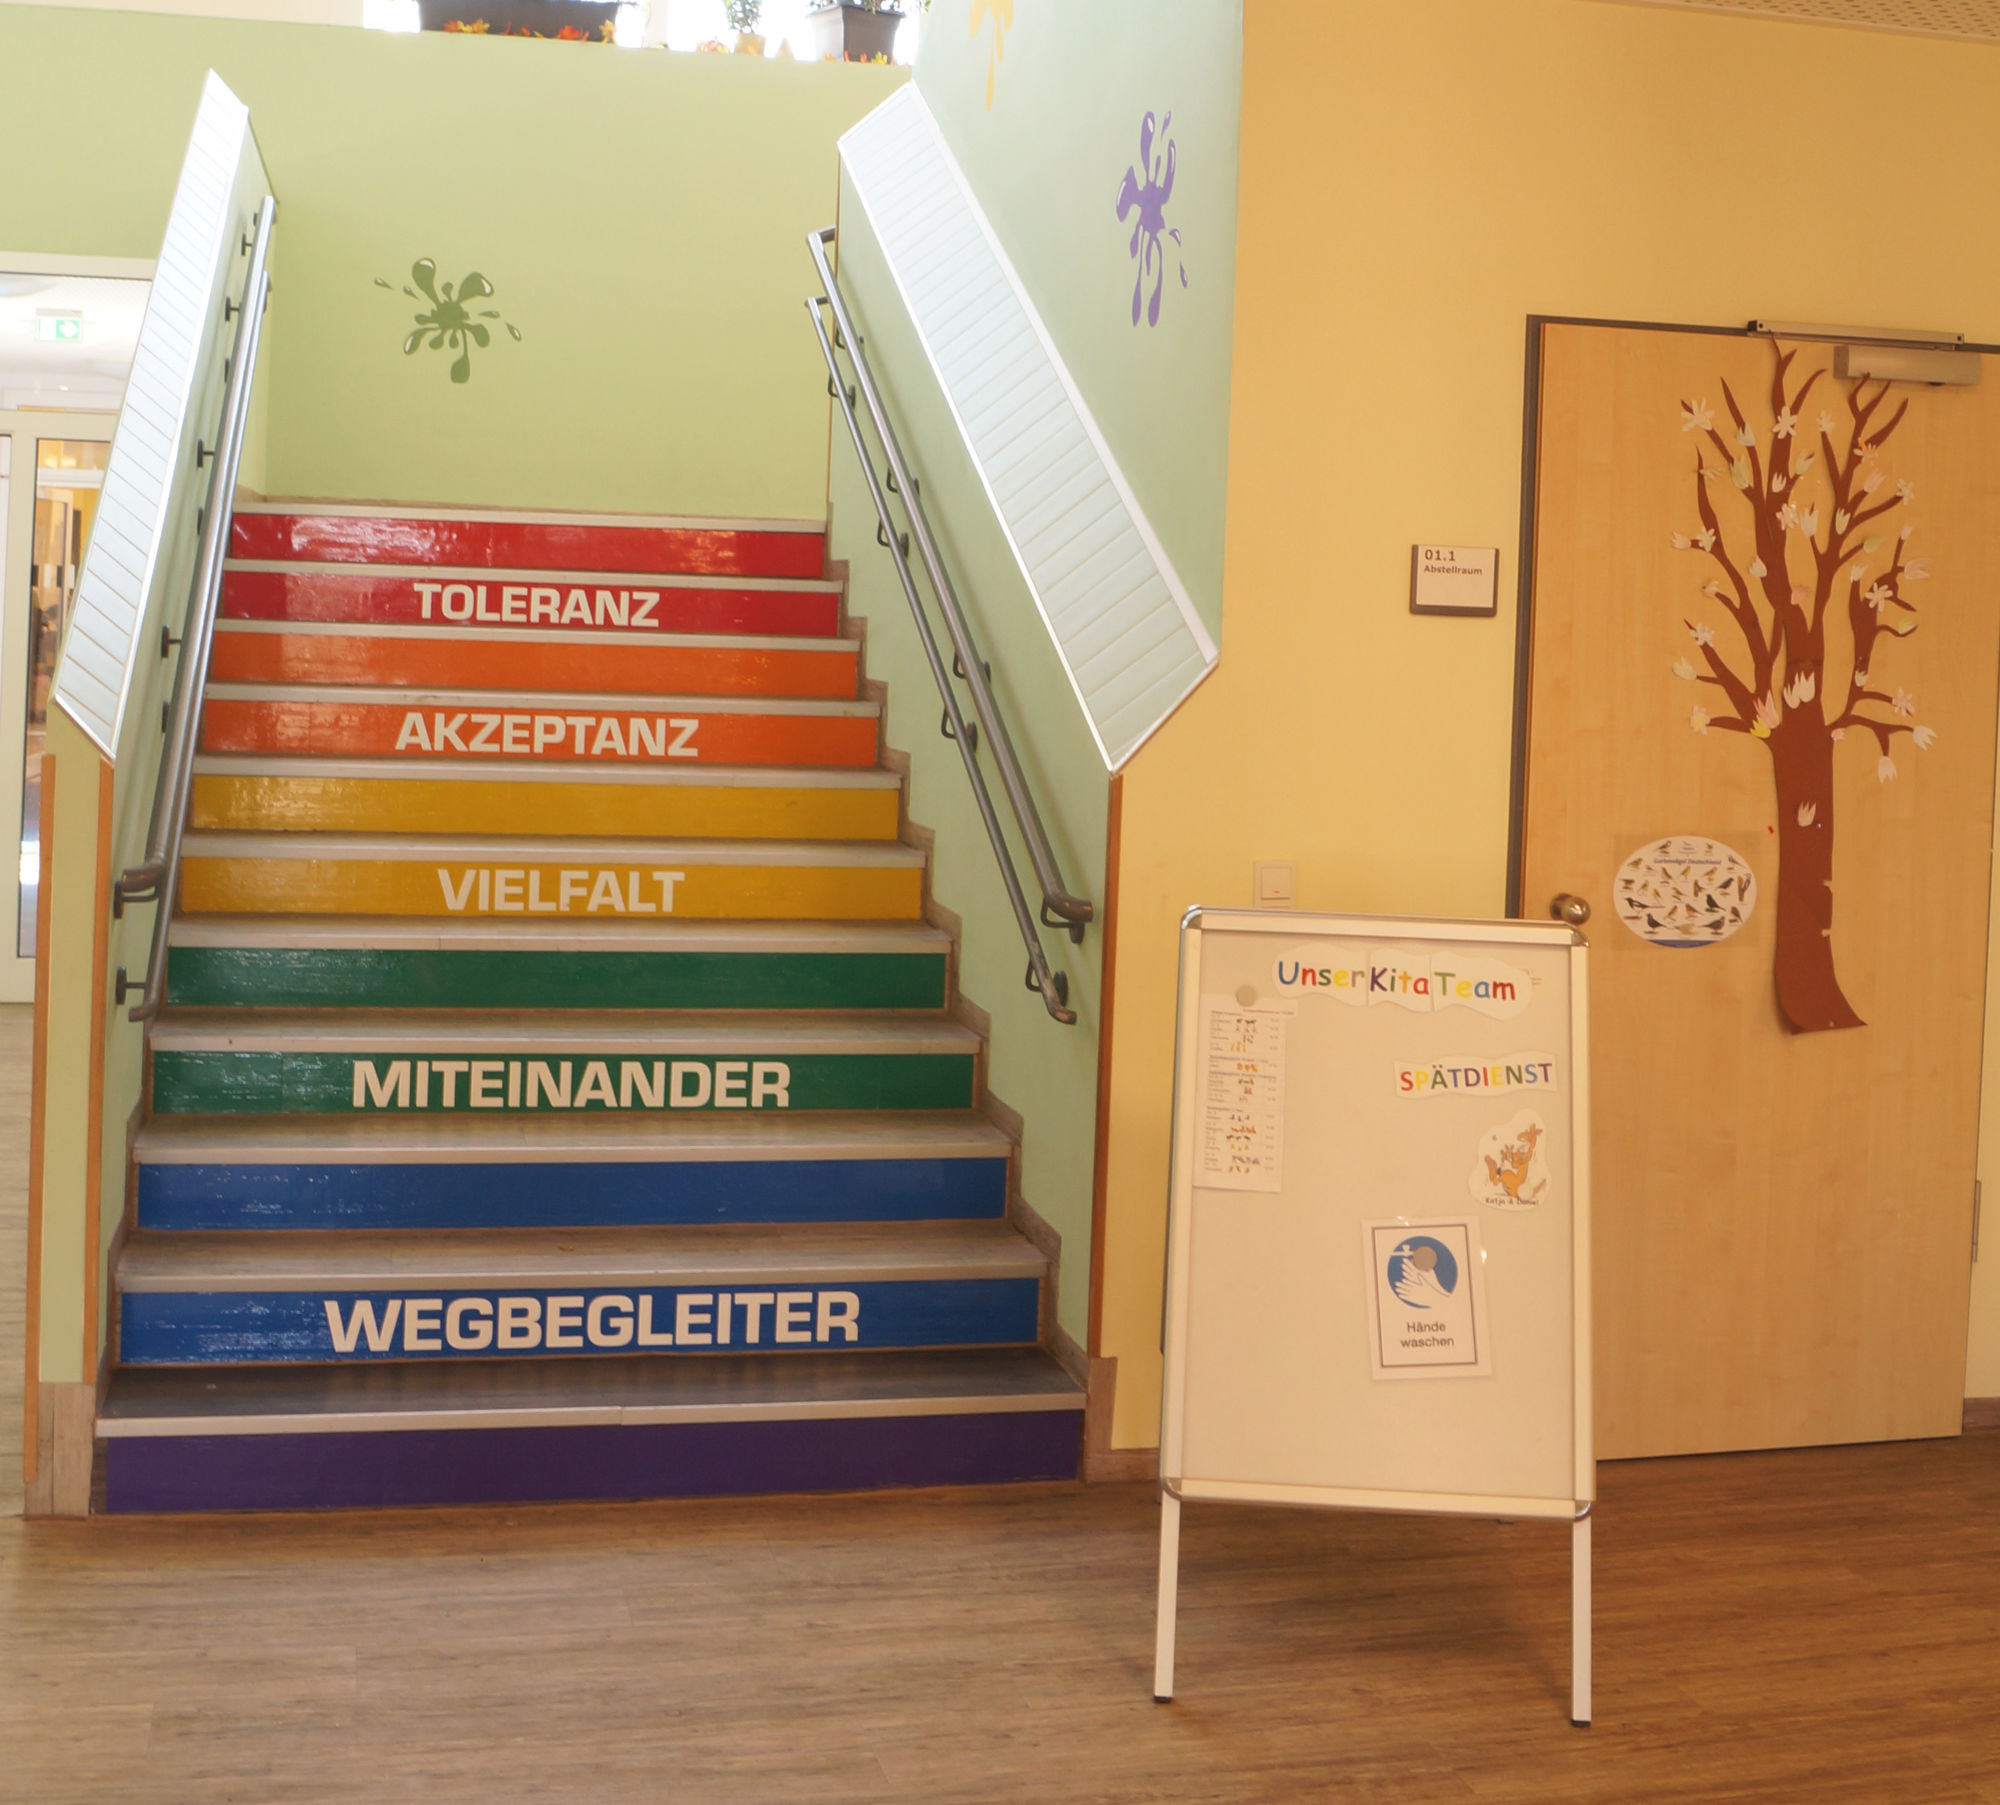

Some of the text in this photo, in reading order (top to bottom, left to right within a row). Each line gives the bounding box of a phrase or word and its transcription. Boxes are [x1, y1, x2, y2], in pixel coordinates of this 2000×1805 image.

[1424, 549, 1456, 561] 01.1
[1424, 564, 1482, 575] Abstellraum
[414, 582, 660, 628] TOLERANZ
[395, 712, 699, 757] AKZEPTANZ
[437, 869, 685, 913] VIELFALT
[1278, 960, 1365, 988] Unser
[1370, 966, 1430, 995] Kita
[1434, 971, 1516, 1001] Team
[352, 1060, 791, 1108] MITEINANDER
[1400, 1063, 1552, 1092] SPÄTDIENST
[323, 1291, 861, 1353] WEGBEGLEITER
[1400, 1336, 1455, 1348] waschen
[1407, 1321, 1446, 1333] Hände
